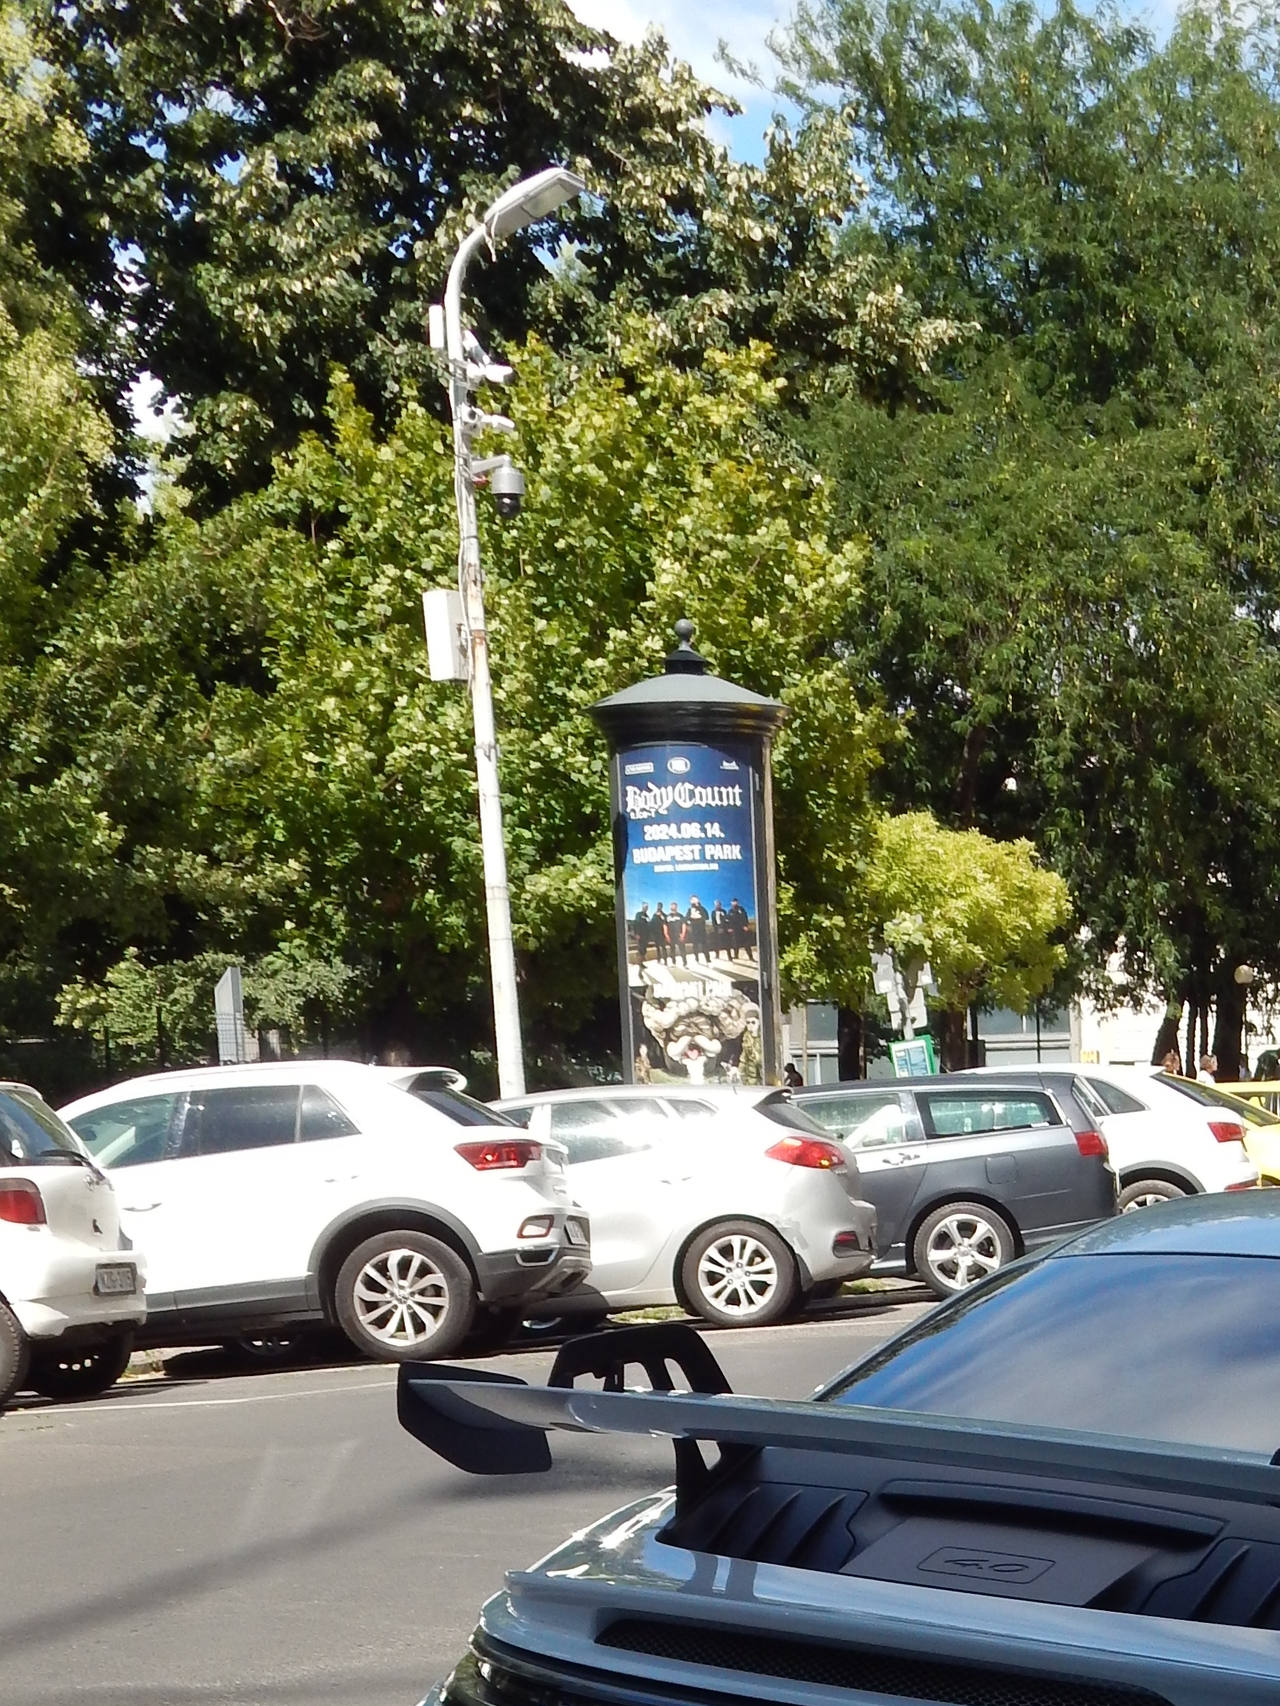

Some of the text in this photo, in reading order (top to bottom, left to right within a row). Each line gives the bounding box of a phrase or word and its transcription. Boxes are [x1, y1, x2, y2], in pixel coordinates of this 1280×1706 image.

[626, 781, 743, 814] Body Count
[643, 822, 725, 841] 2024.06.14.
[632, 844, 742, 864] BUDAPEST PARK
[944, 1558, 1030, 1573] 4.0
